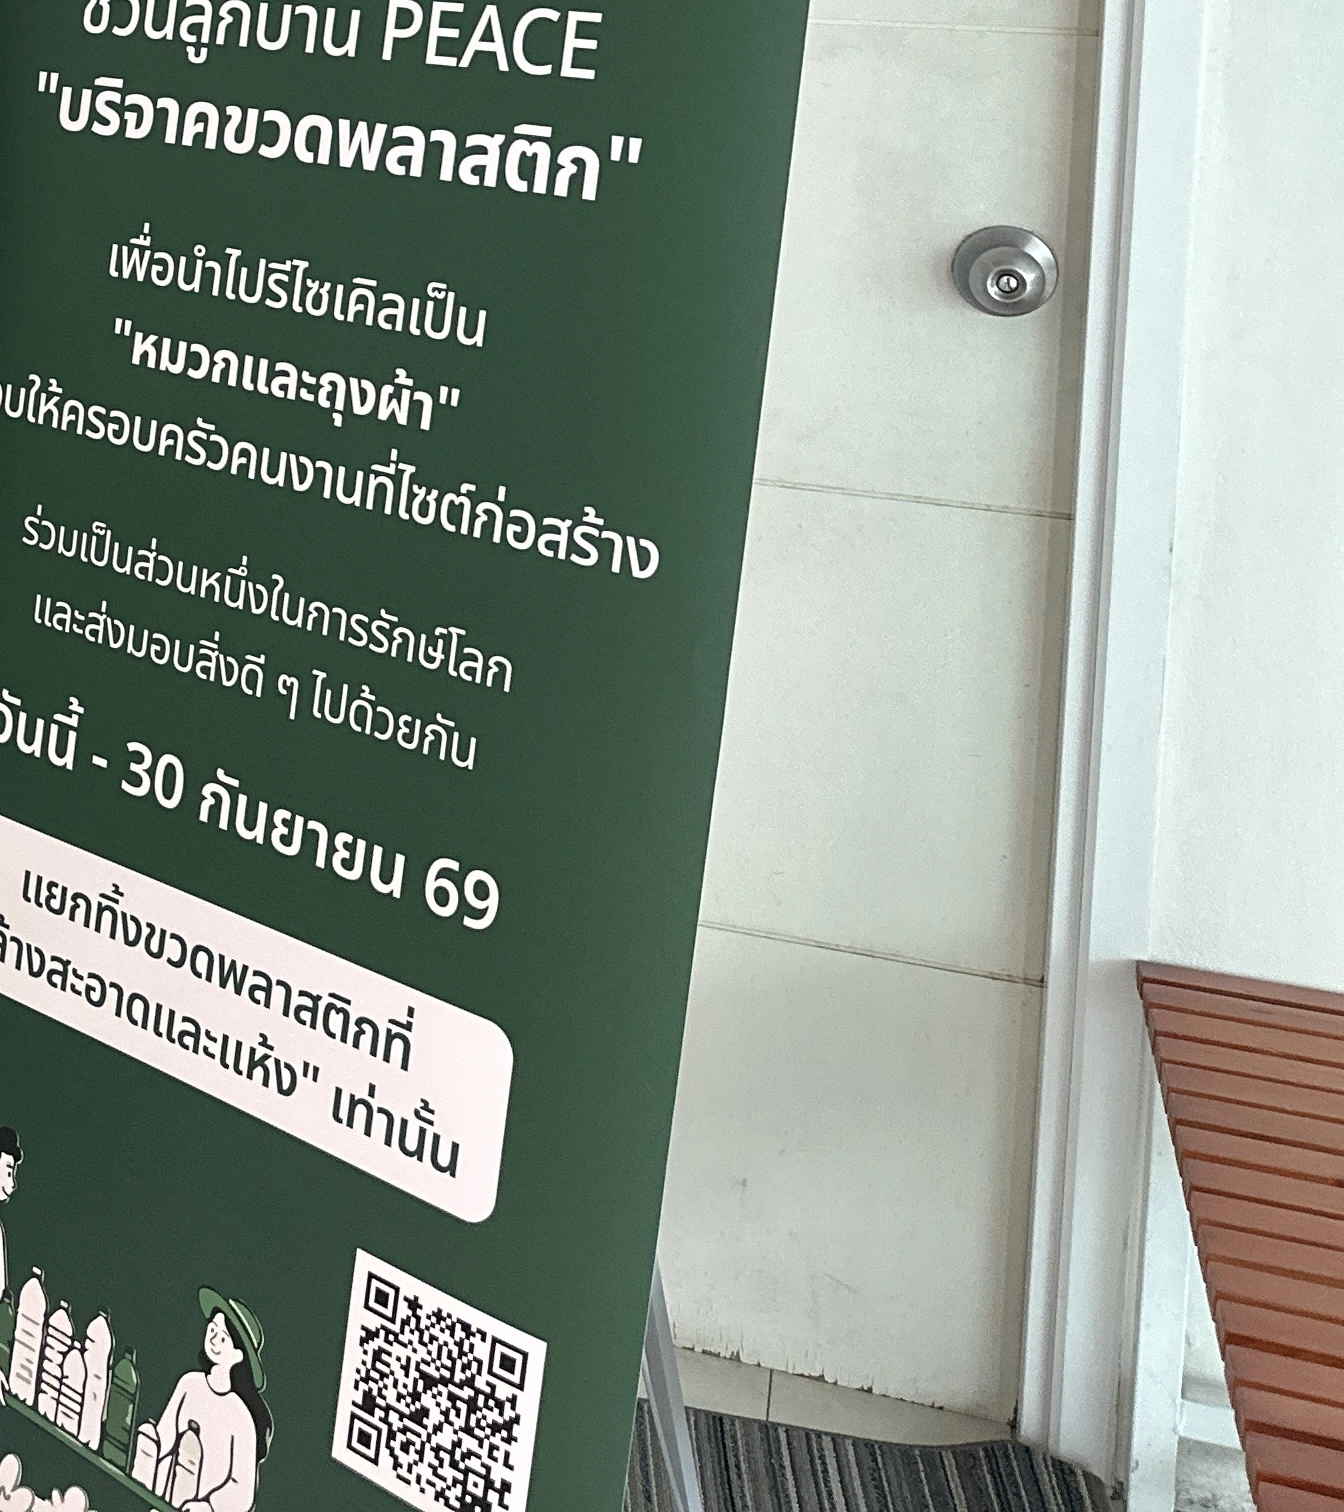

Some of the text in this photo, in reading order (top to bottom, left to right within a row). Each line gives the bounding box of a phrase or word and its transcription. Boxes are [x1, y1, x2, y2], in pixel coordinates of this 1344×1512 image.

[38, 70, 643, 201] "บริจาคขวดพลาสติก"
[109, 222, 487, 348] เพื่อนำไปรีไซเคิลเป็น
[114, 317, 461, 431] "หมวกและถุงผ้า"
[22, 506, 513, 693] ร่วมเป็นส่วนหนึ่งในการรักษ์โลก
[34, 593, 266, 698] และส่งมอบสิ่งดี
[311, 669, 477, 770] ไปด้วยกัน
[91, 754, 108, 769] -
[121, 741, 184, 809] 30
[199, 767, 406, 899] กันยายน
[424, 857, 500, 930] 69
[22, 869, 415, 1072] แยกทิ้งขวดพลาสติกที่
[332, 1082, 460, 1179] เท่านั้น
